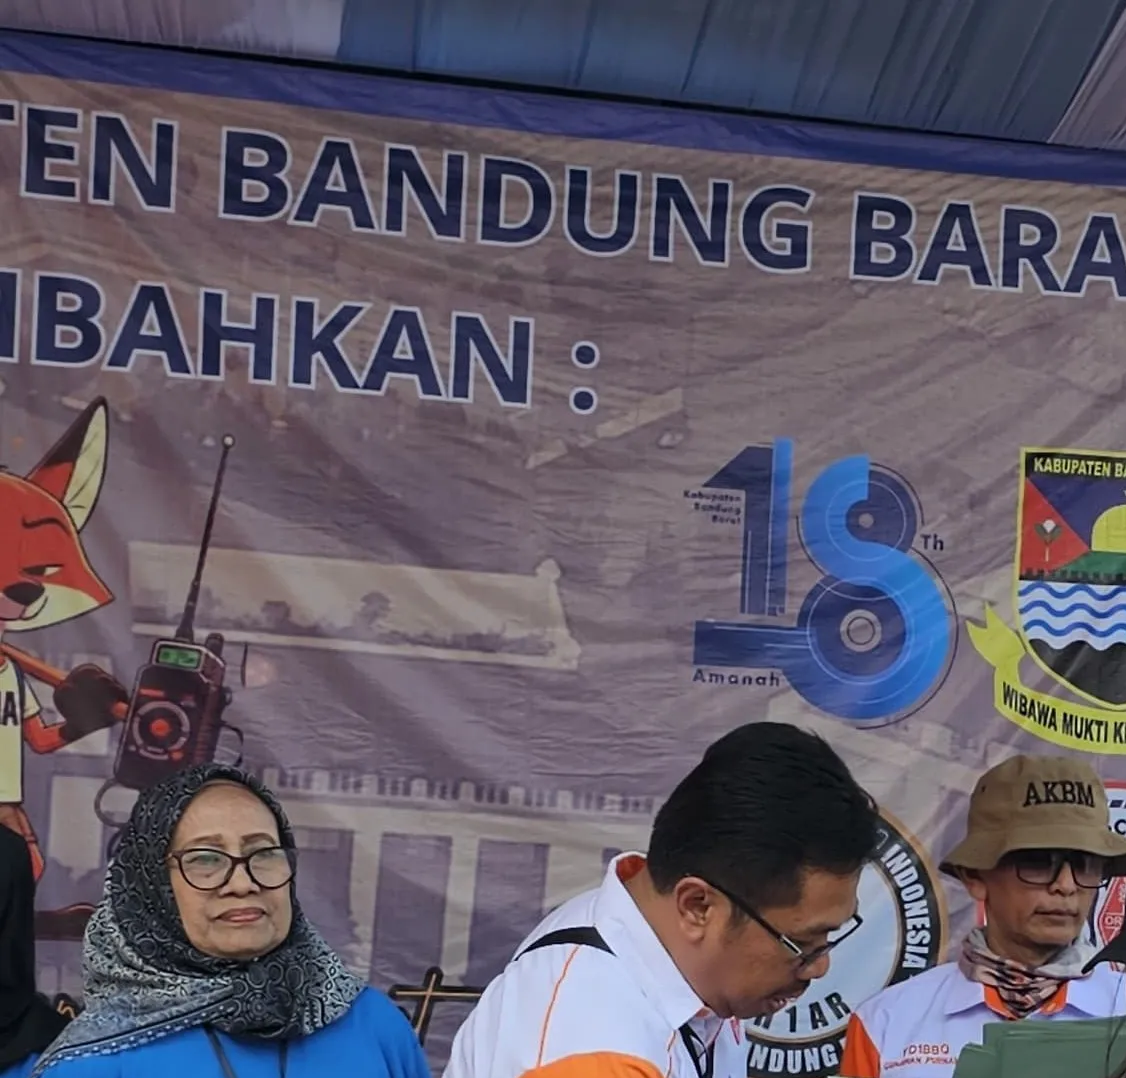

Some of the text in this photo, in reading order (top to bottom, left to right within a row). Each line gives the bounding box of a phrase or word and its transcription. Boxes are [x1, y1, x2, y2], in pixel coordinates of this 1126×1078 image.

[218, 126, 815, 276] BANDUNG
[1033, 456, 1111, 477] KABUPATEN
[920, 534, 945, 551] Th
[692, 668, 780, 687] Amanah
[1002, 681, 1058, 732] WIBAWA
[1061, 712, 1109, 743] MUKTI
[1022, 780, 1096, 808] AKBM
[880, 844, 931, 969] INDONESIA
[748, 1042, 839, 1073] NDUNG
